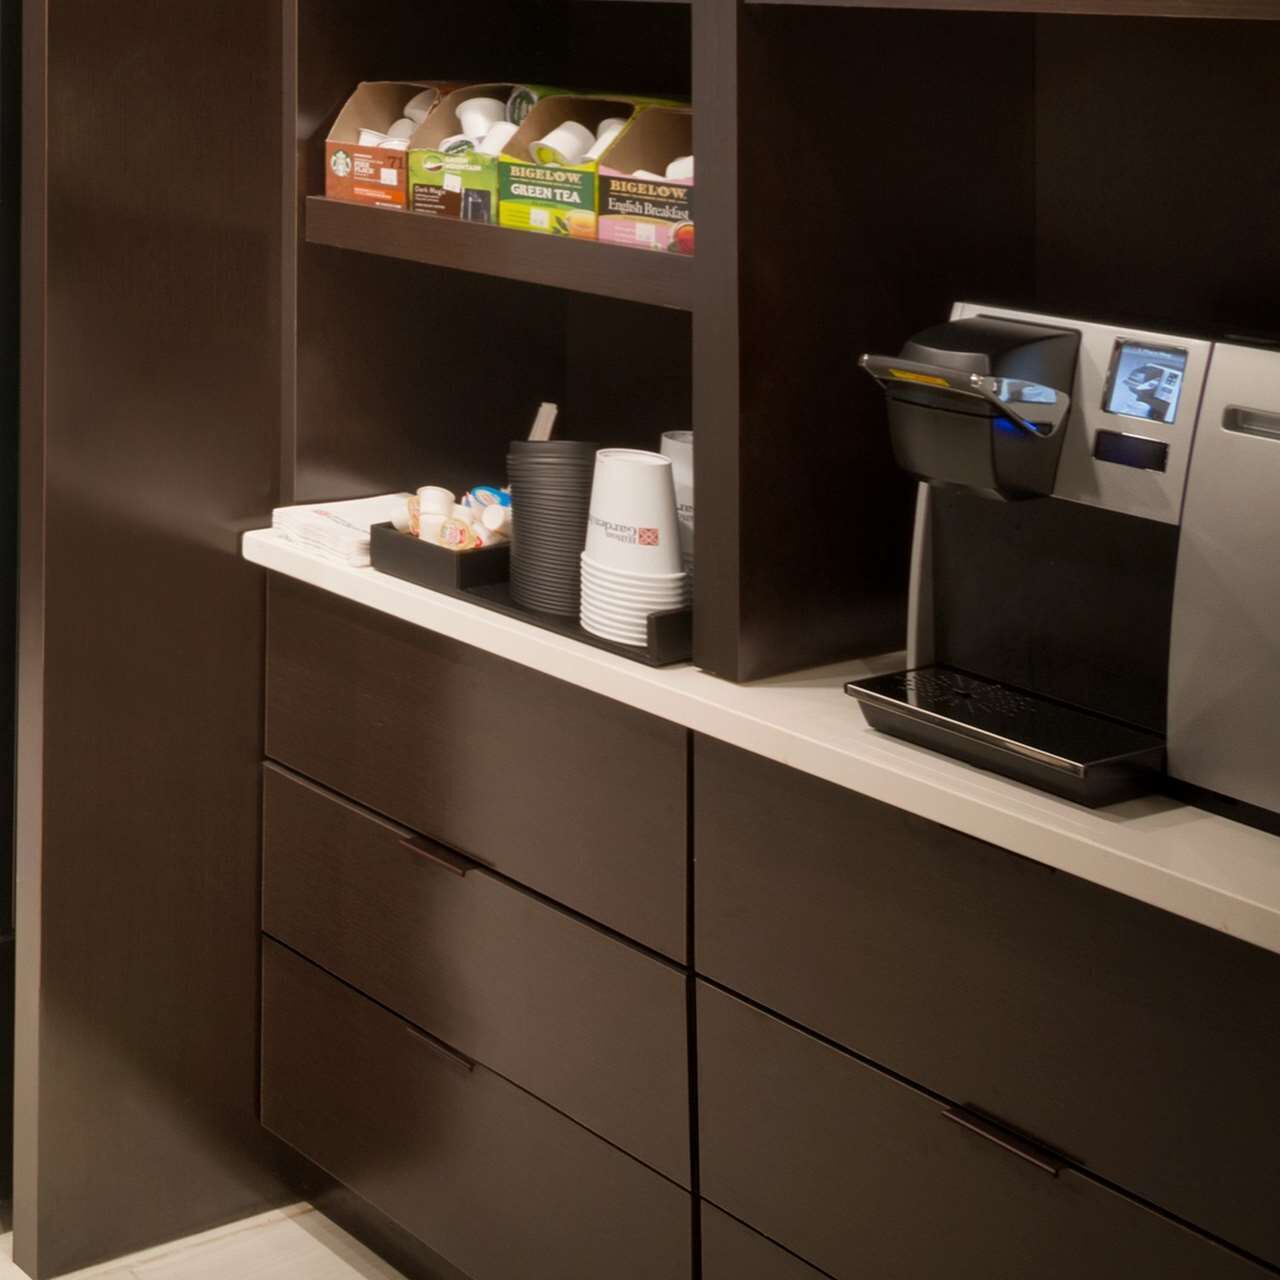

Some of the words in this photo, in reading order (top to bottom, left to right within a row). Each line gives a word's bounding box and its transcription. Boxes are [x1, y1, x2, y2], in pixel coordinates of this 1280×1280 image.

[510, 166, 581, 184] BIGELOW
[511, 183, 553, 199] GREEN
[558, 190, 581, 204] TEA
[610, 180, 687, 200] BIGELOW
[608, 197, 643, 216] English
[644, 202, 689, 221] Breakfast
